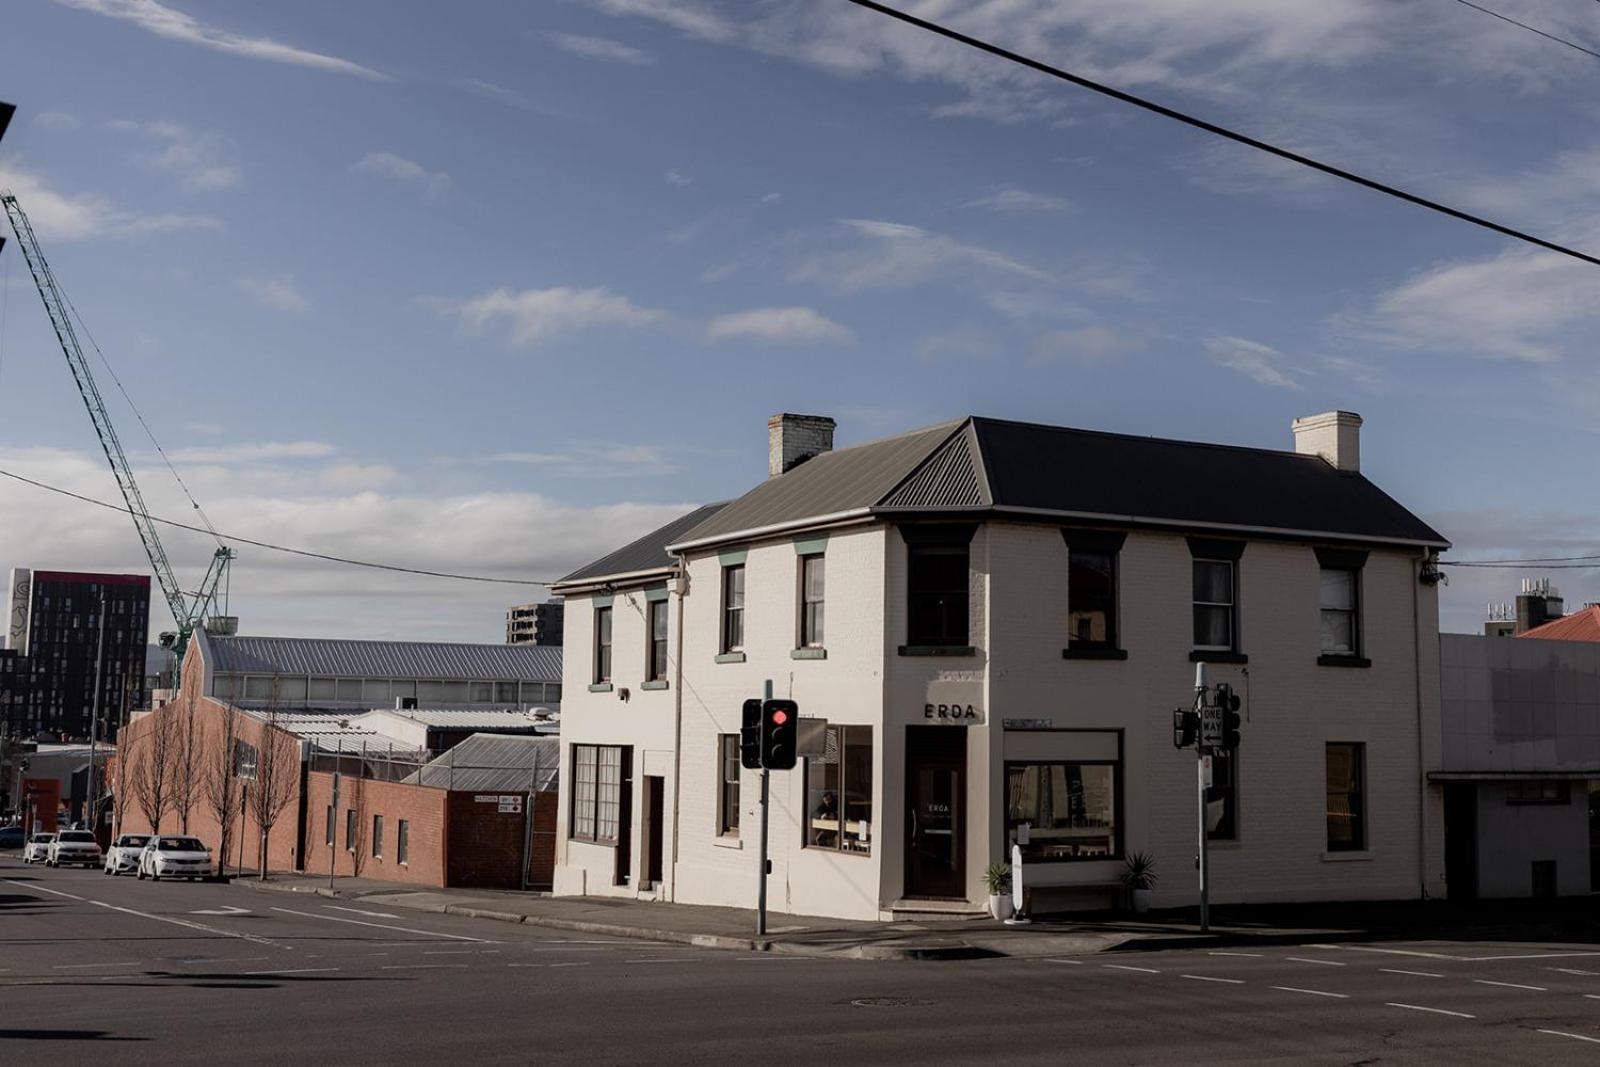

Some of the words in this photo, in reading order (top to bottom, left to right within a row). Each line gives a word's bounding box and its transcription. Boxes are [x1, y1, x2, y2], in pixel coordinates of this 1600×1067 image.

[924, 704, 976, 719] ERDA
[1204, 709, 1221, 719] ONE
[1203, 722, 1222, 732] WAY
